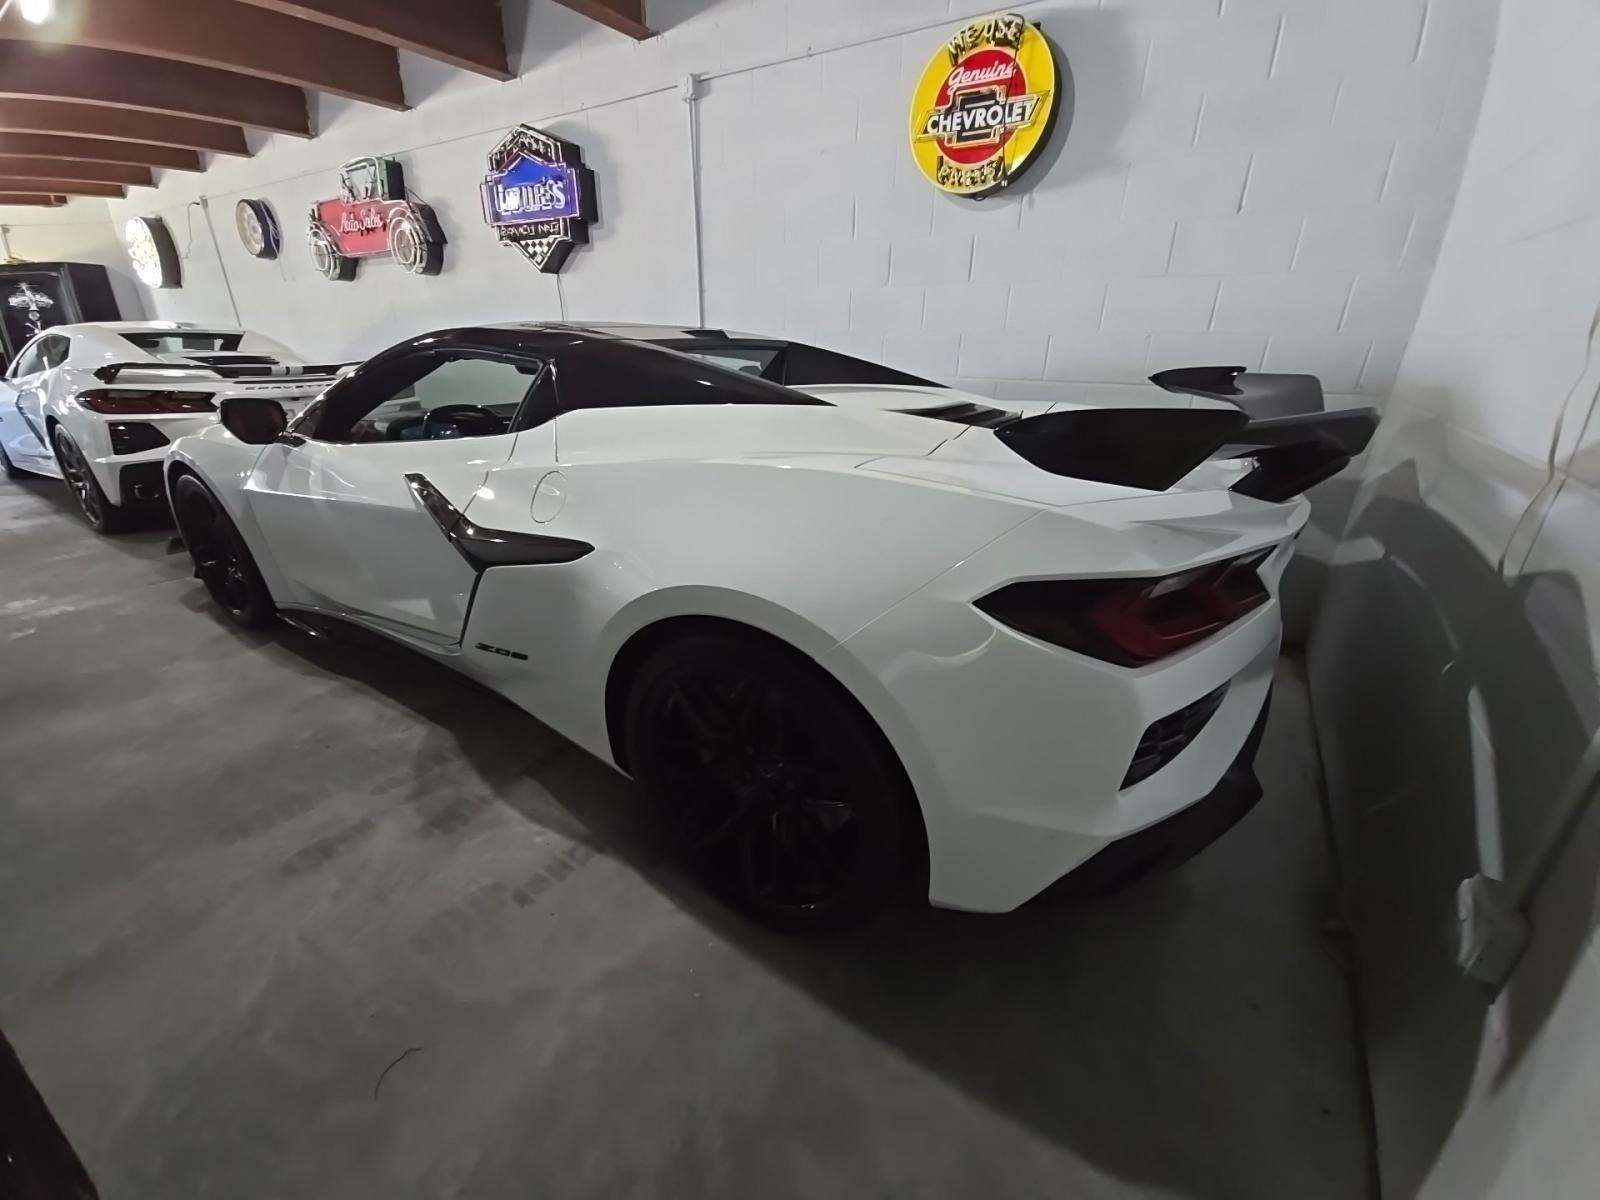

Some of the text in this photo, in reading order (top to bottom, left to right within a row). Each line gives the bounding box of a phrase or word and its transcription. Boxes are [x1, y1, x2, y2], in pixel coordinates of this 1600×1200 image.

[947, 60, 1017, 94] Genuine
[927, 101, 1034, 135] CHEVROLET
[340, 207, 384, 233] Auto Sales
